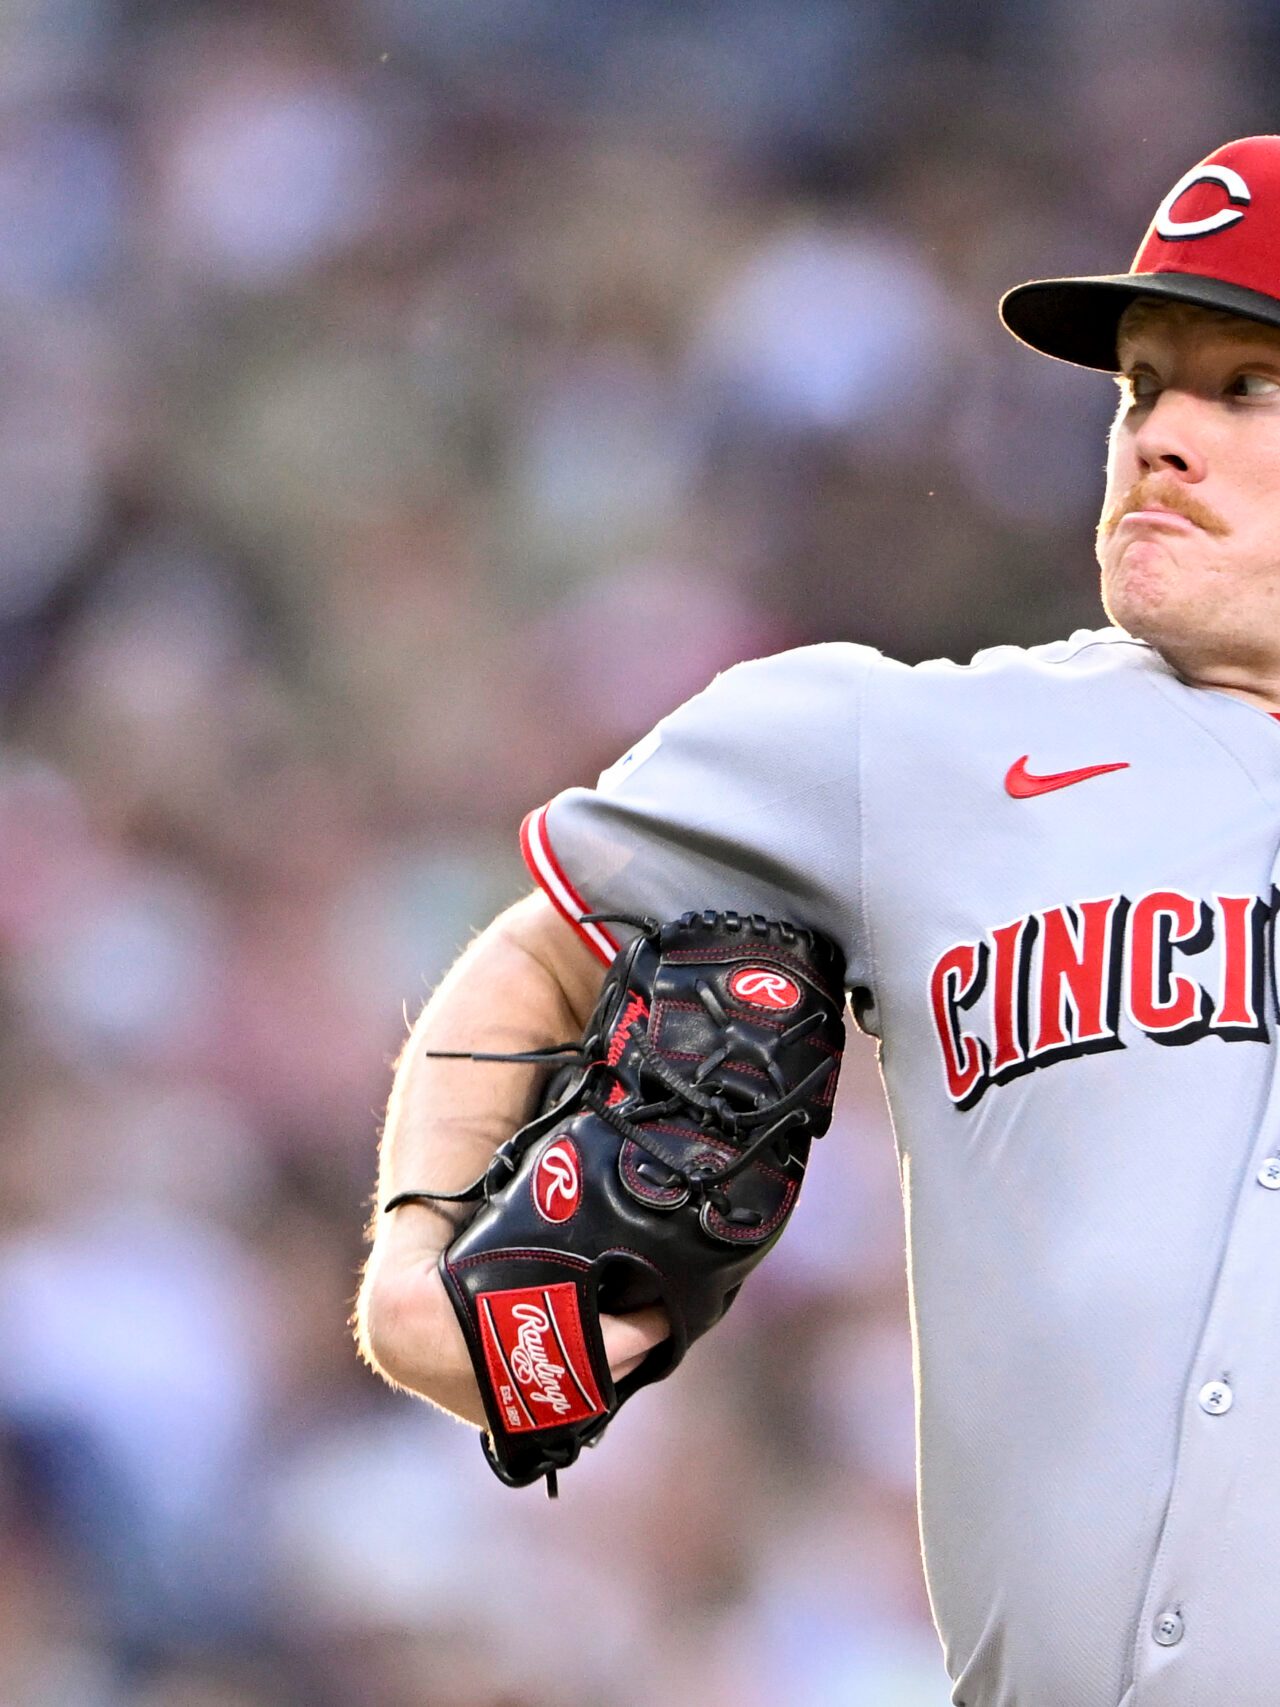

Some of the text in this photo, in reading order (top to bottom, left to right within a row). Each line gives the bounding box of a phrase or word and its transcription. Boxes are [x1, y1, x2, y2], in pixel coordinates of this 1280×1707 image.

[1155, 164, 1251, 242] C
[735, 972, 787, 1005] R
[541, 1147, 578, 1212] R
[512, 1303, 571, 1415] Rawlings
